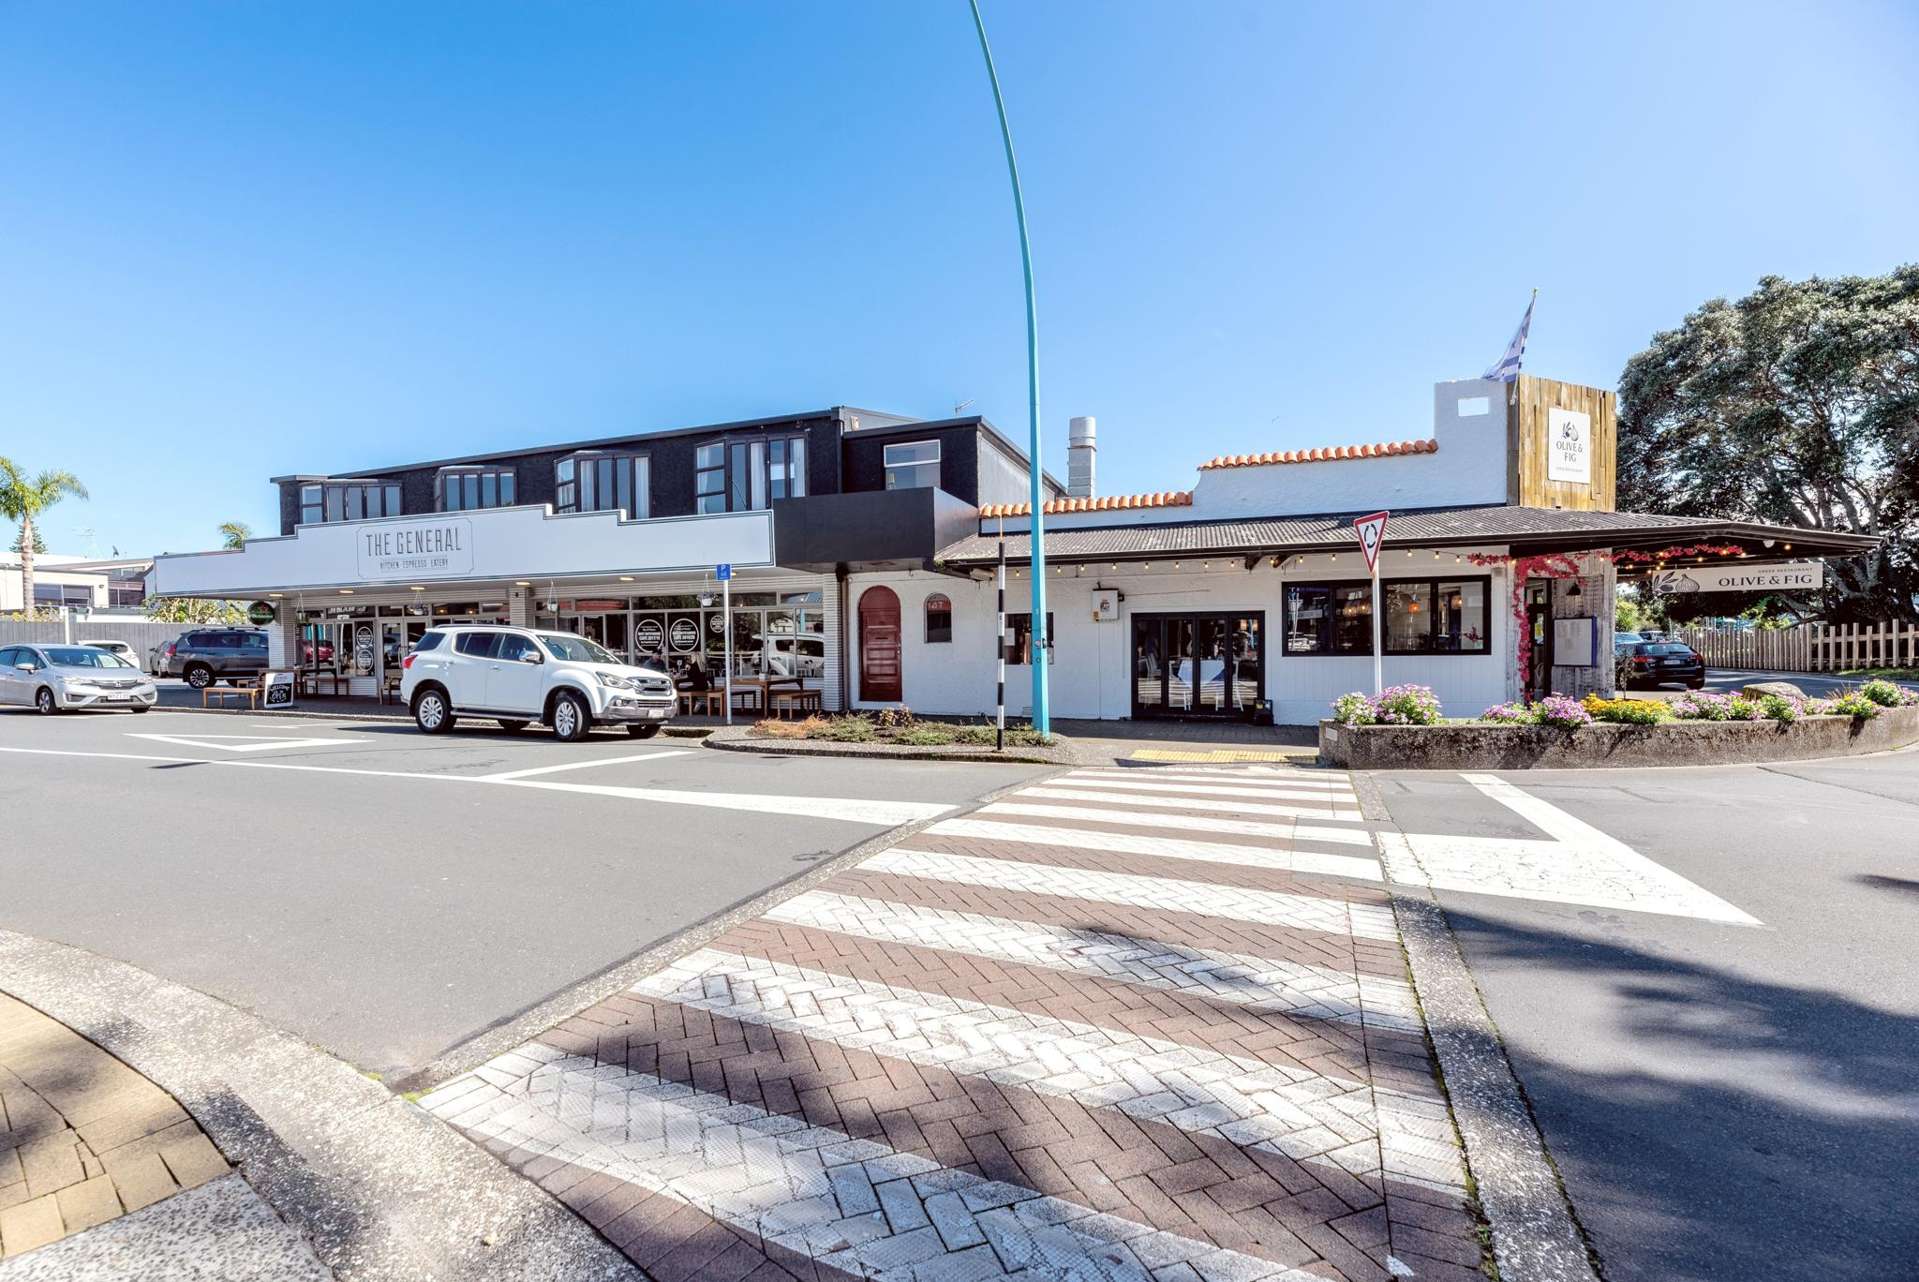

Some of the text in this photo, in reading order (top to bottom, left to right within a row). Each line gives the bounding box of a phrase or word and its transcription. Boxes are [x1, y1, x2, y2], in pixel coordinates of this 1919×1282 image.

[1556, 440, 1577, 452] OLIVE
[1564, 452, 1577, 463] FIG
[366, 527, 462, 557] THE GENERAL
[1718, 574, 1813, 587] OLIVE & FIG
